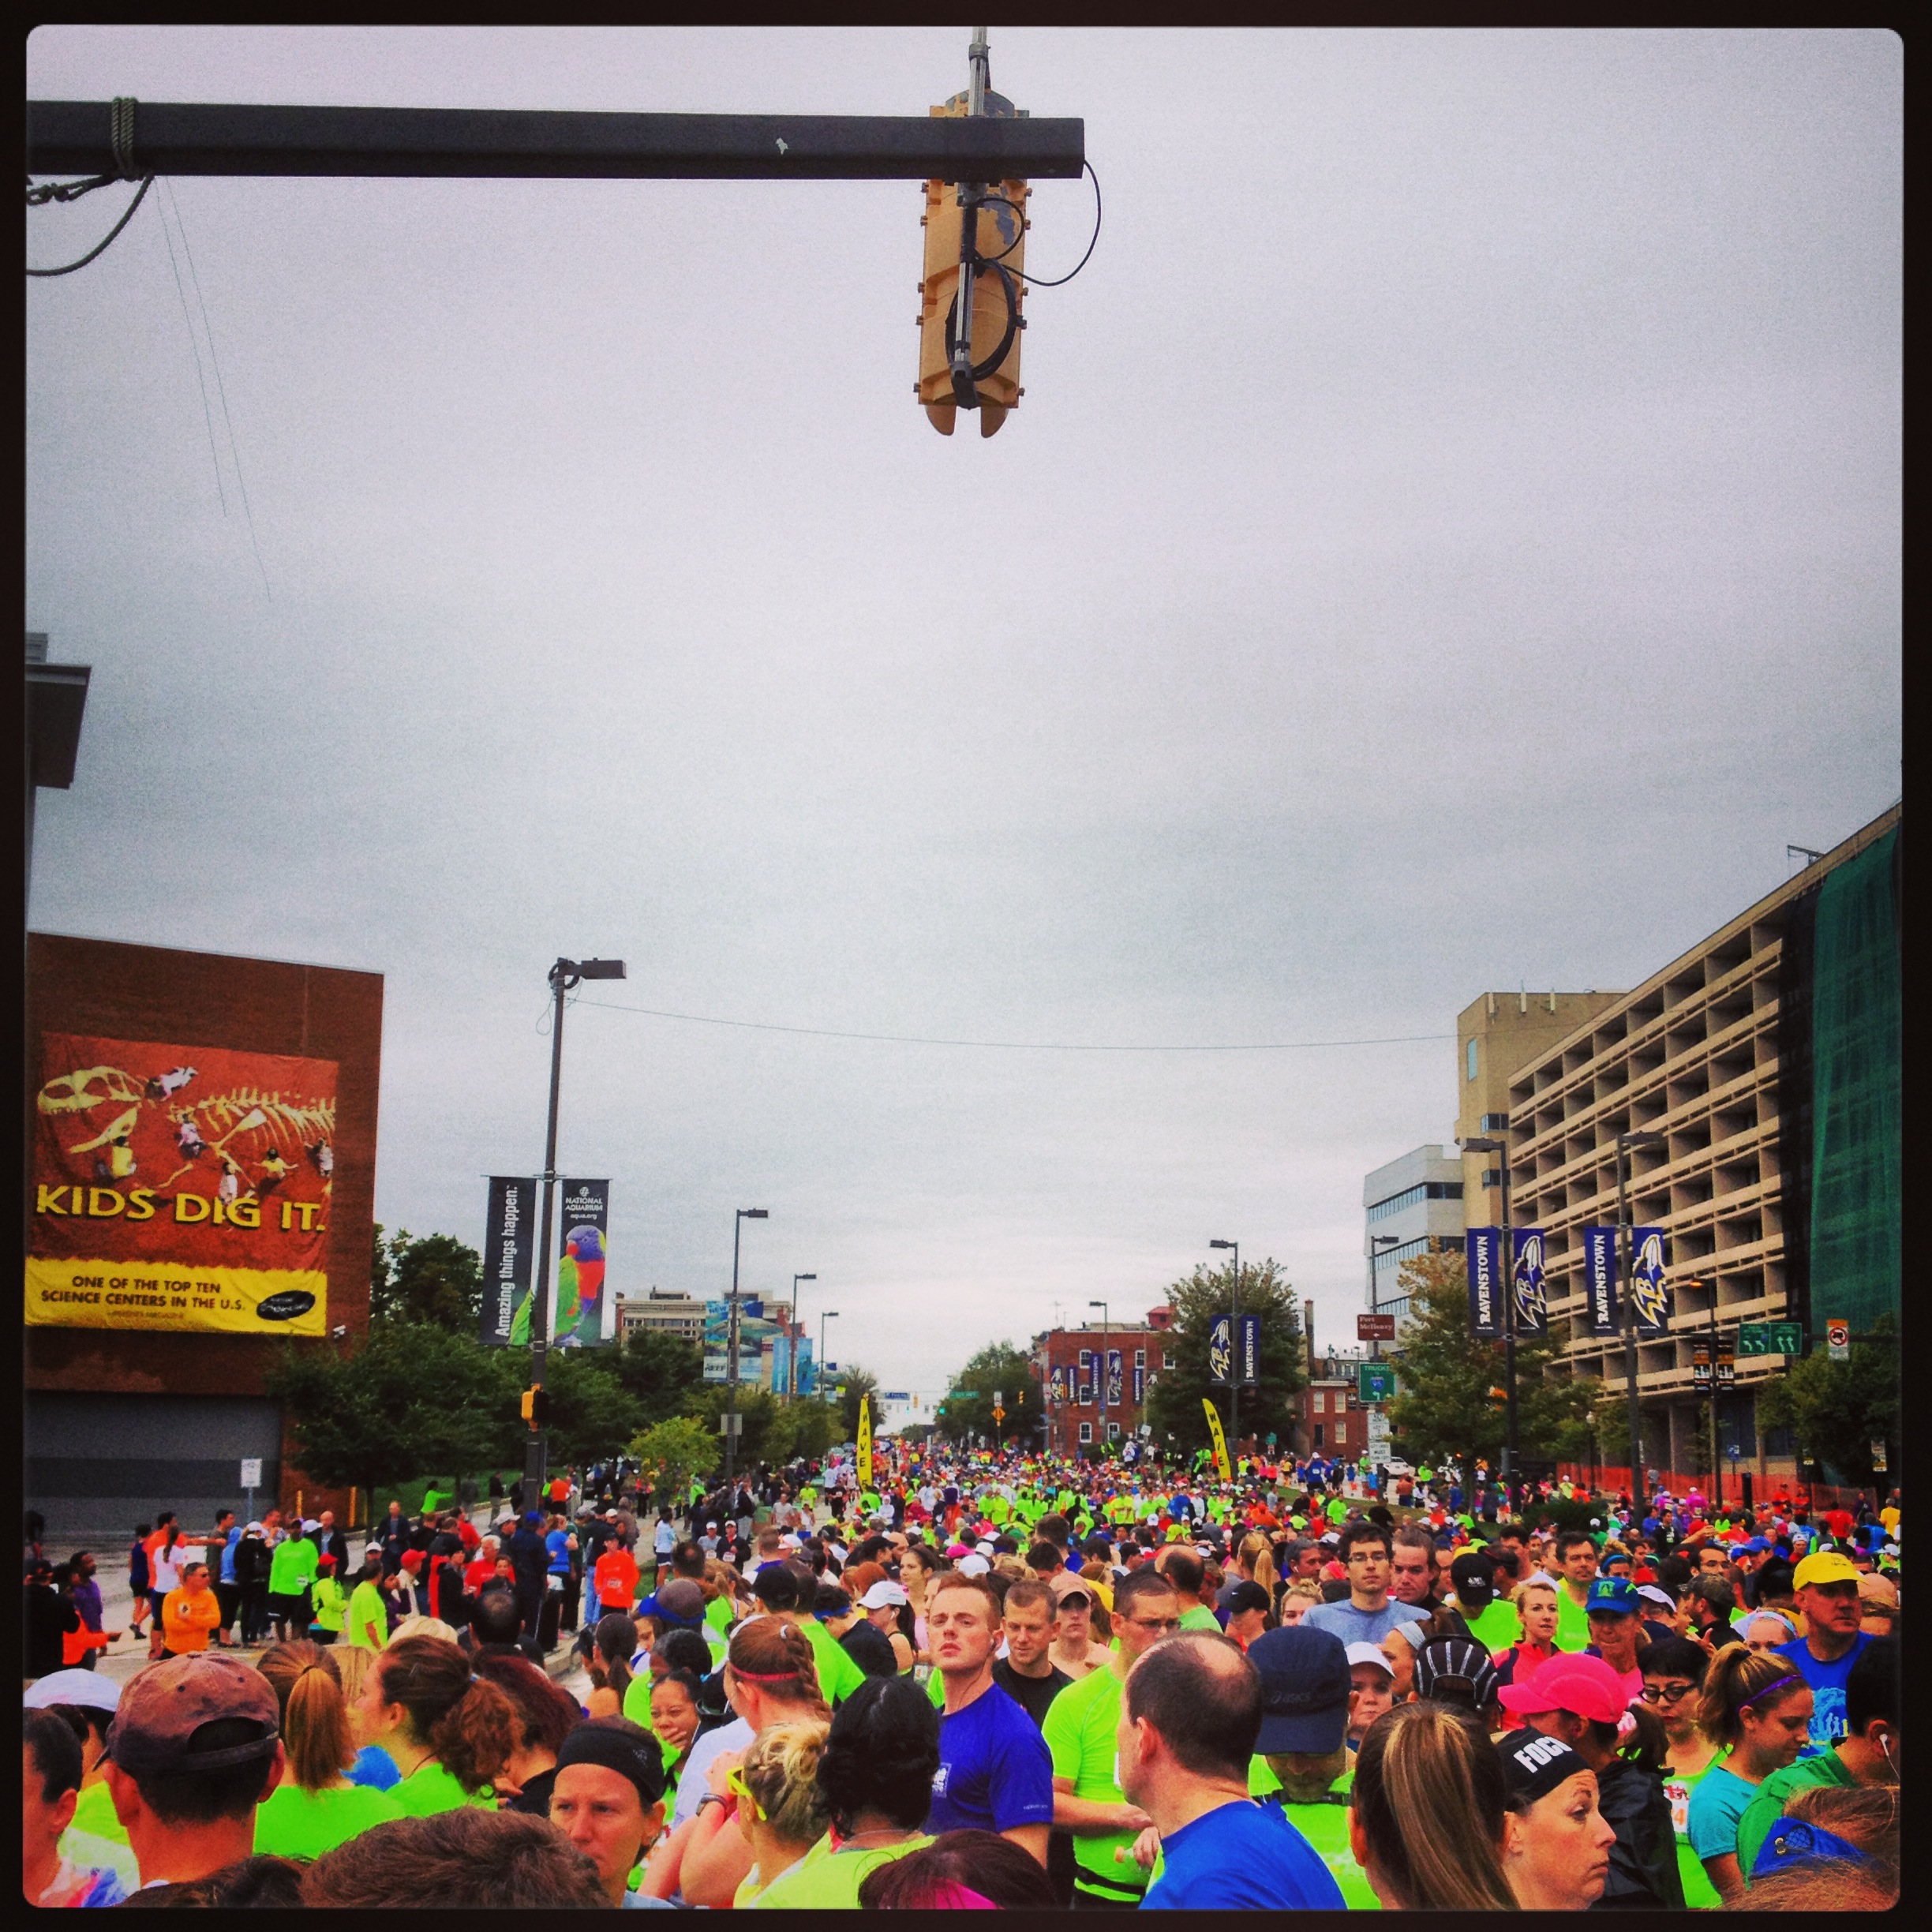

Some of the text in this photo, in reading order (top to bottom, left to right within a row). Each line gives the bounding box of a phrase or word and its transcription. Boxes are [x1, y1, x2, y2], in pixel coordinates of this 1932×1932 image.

[37, 1184, 325, 1231] KIDS DIG IT.
[499, 1239, 518, 1279] things
[1477, 1236, 1491, 1324] RAVENSTOWN
[1593, 1234, 1609, 1324] RAVENSTOWN
[41, 1290, 245, 1311] SCIENCE CENTERS IN THE U.S.
[72, 1275, 221, 1294] ONE OF THE TOP TEN
[495, 1282, 515, 1337] Amazing
